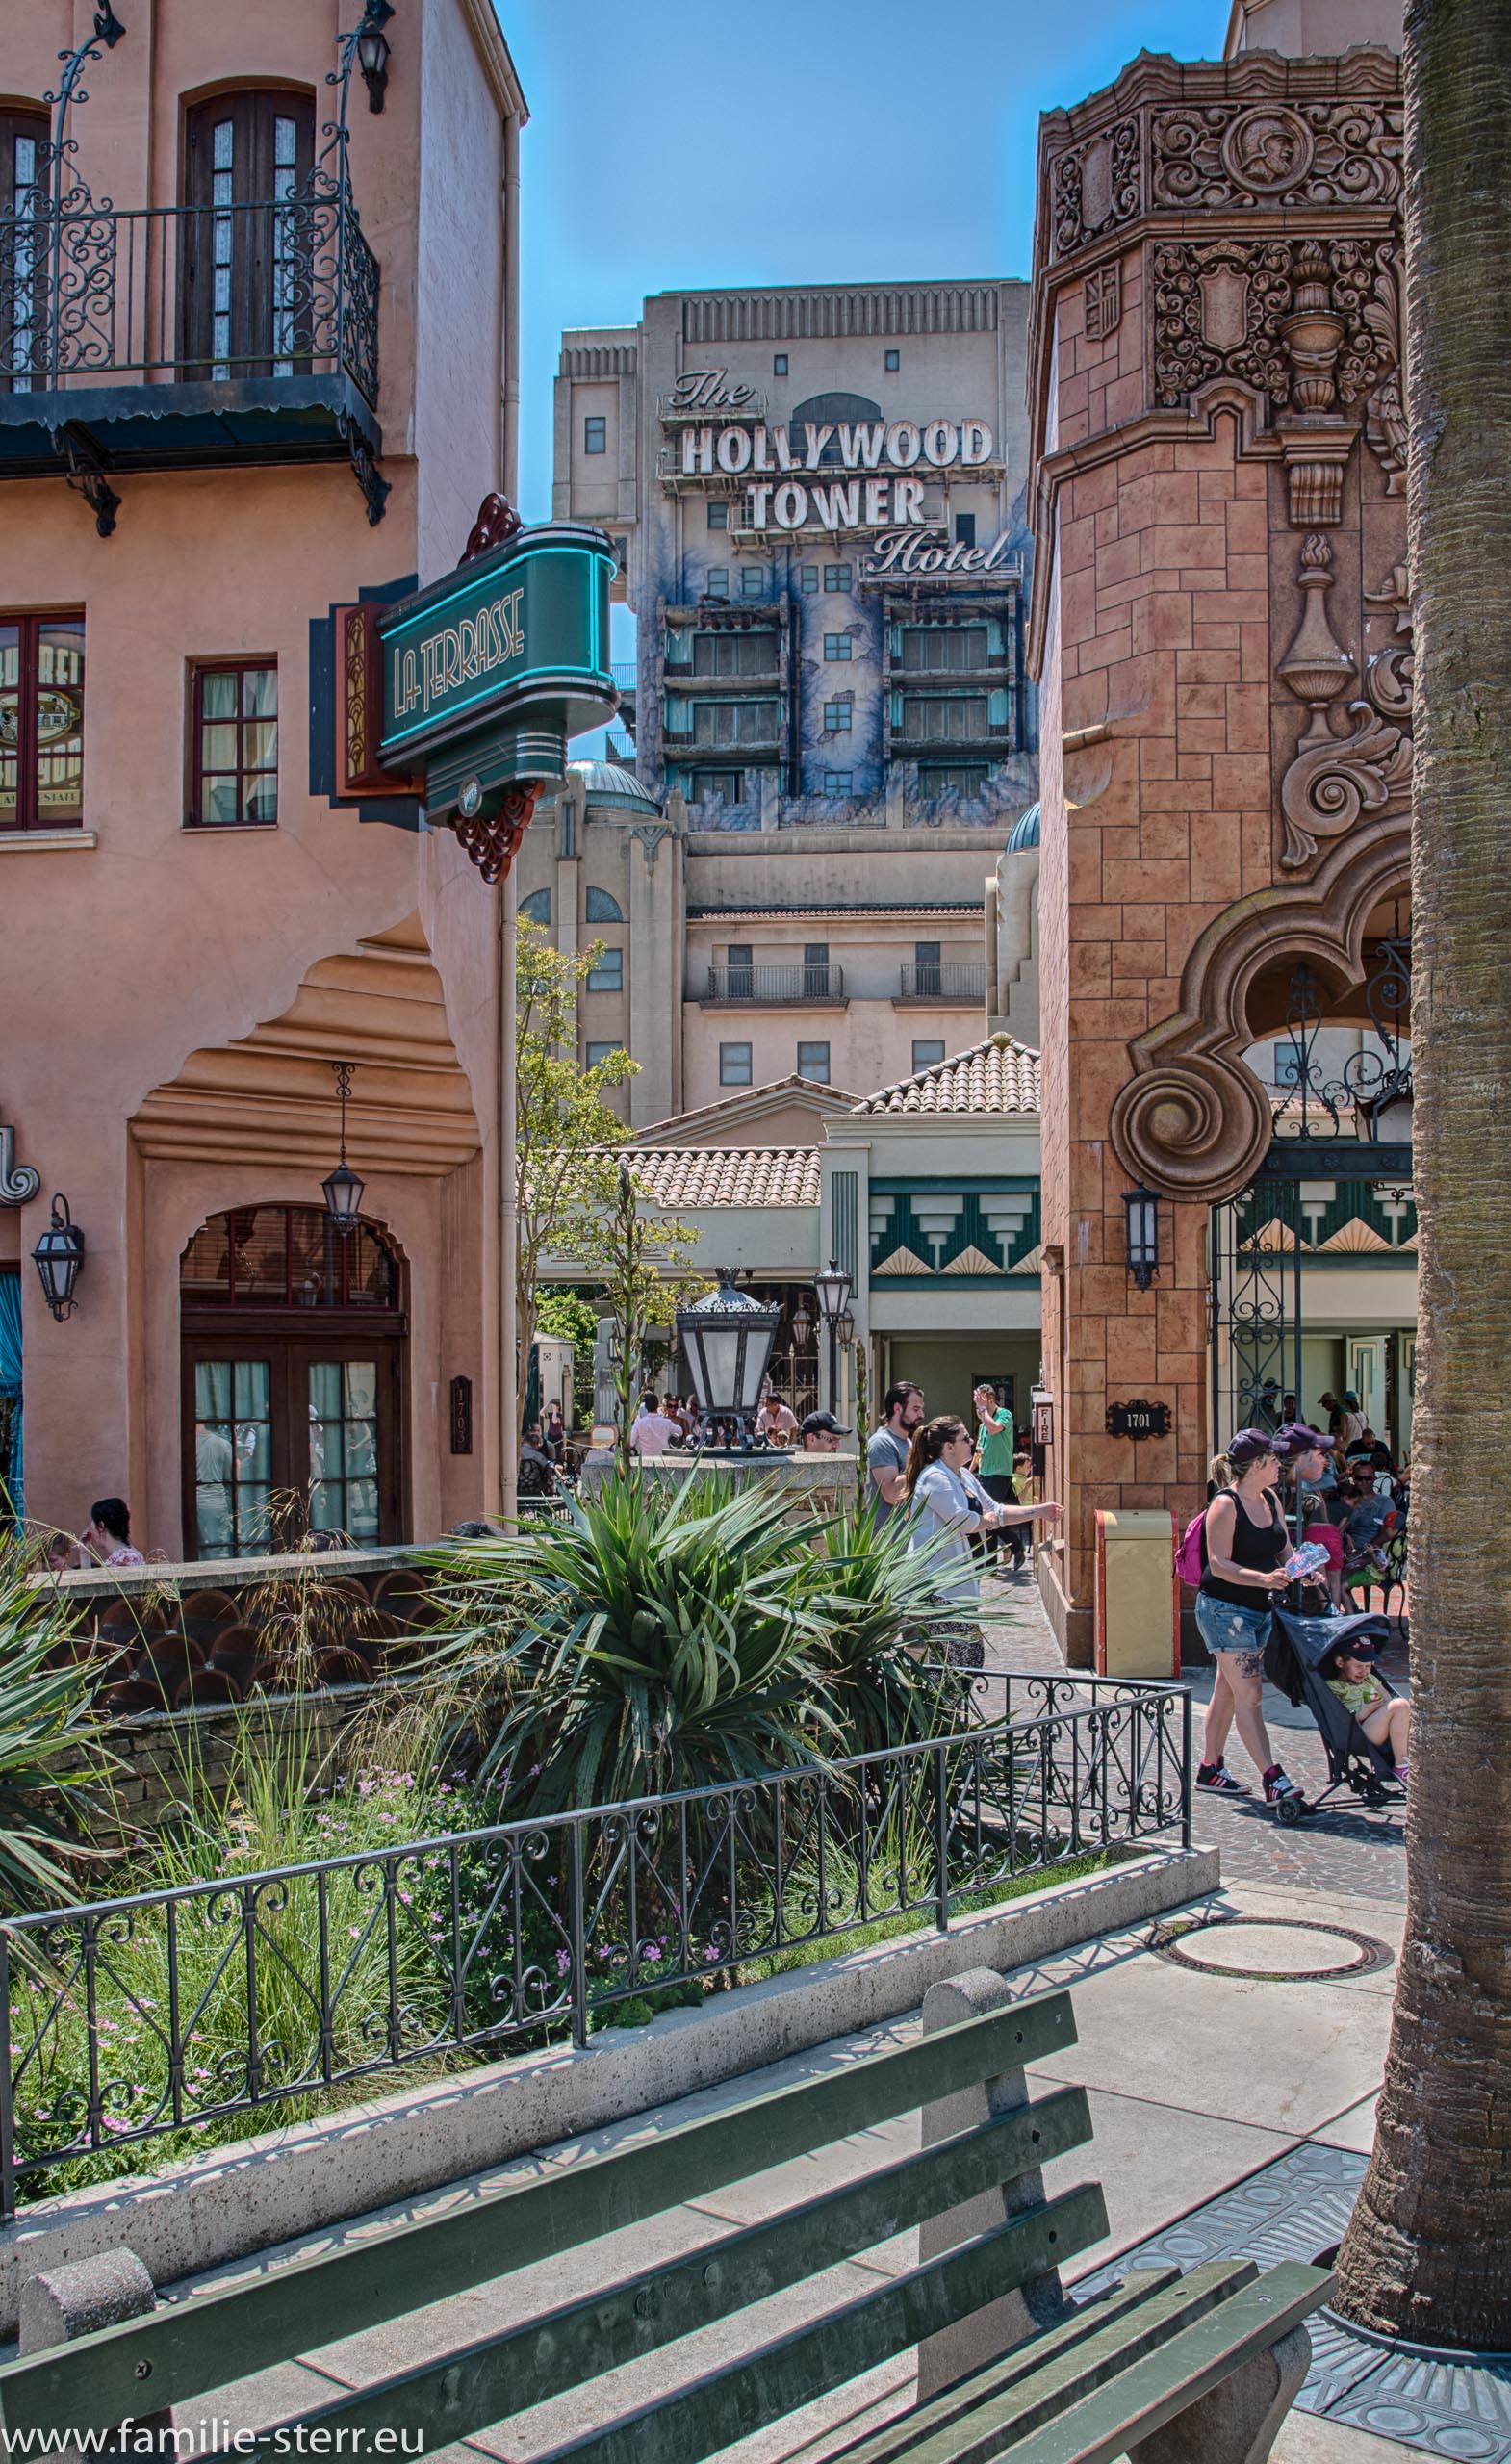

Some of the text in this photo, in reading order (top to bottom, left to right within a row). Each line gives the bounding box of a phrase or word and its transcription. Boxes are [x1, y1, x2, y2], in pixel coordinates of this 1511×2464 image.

[668, 368, 756, 407] The
[682, 418, 993, 475] HOLLYWOOD
[747, 478, 927, 531] TOWER
[866, 528, 1012, 574] Hotel
[395, 587, 525, 718] LA TERRASSE
[1040, 1409, 1050, 1441] FIRE
[1127, 1414, 1150, 1428] 1701
